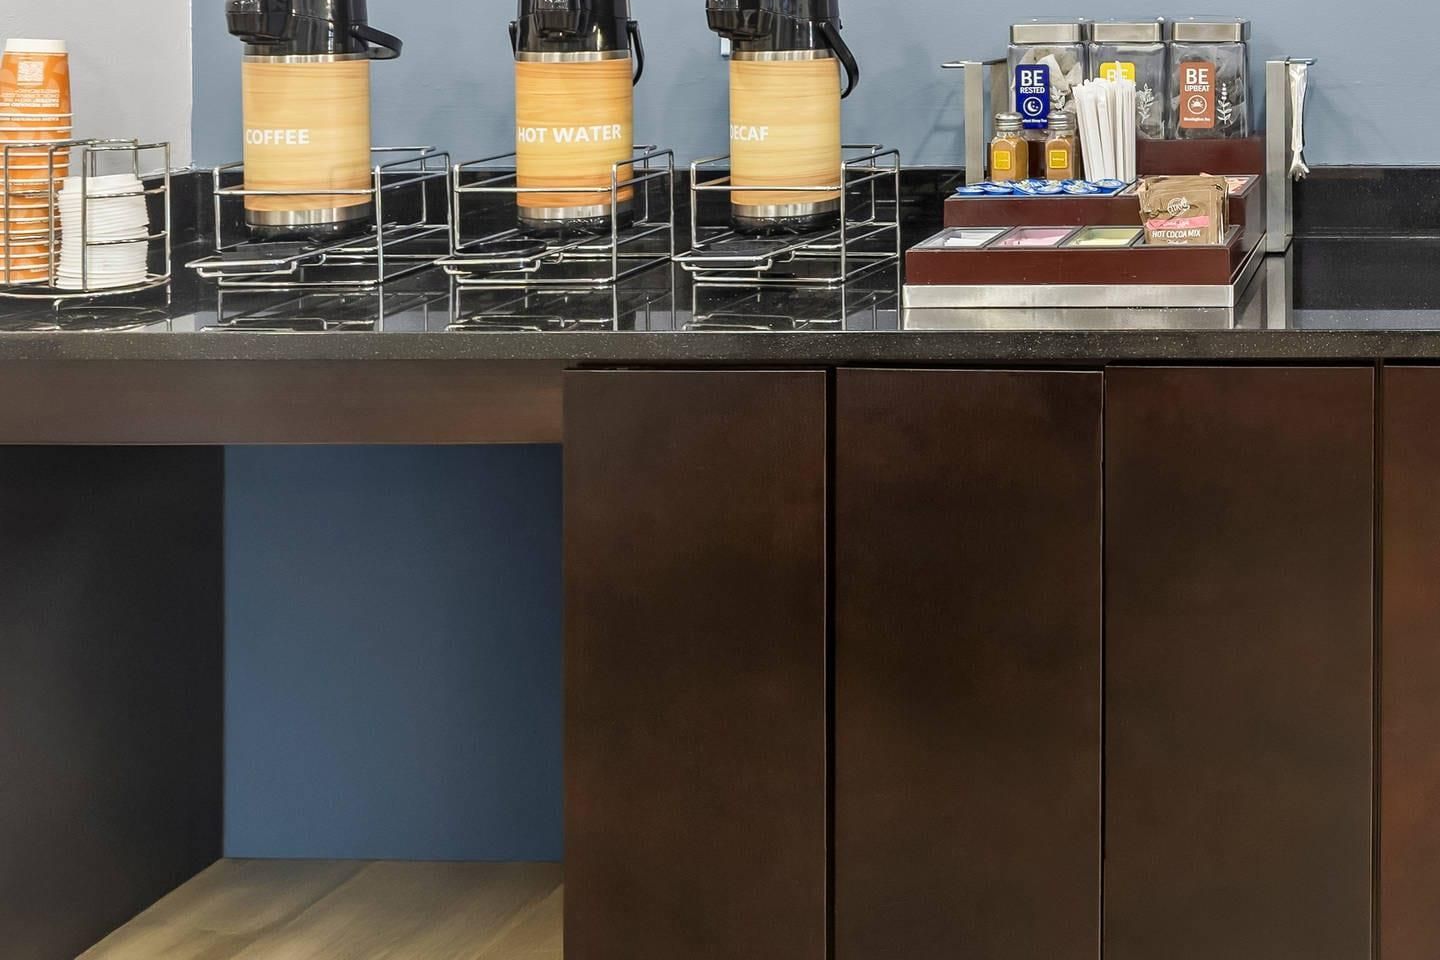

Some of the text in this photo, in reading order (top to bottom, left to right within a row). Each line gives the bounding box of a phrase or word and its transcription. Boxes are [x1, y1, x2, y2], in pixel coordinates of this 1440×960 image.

[1021, 70, 1044, 86] BE
[1185, 68, 1209, 84] BE
[246, 128, 310, 145] COFFEE
[518, 124, 622, 143] HOT WATER
[1152, 228, 1201, 238] HOT COCOA MIX
